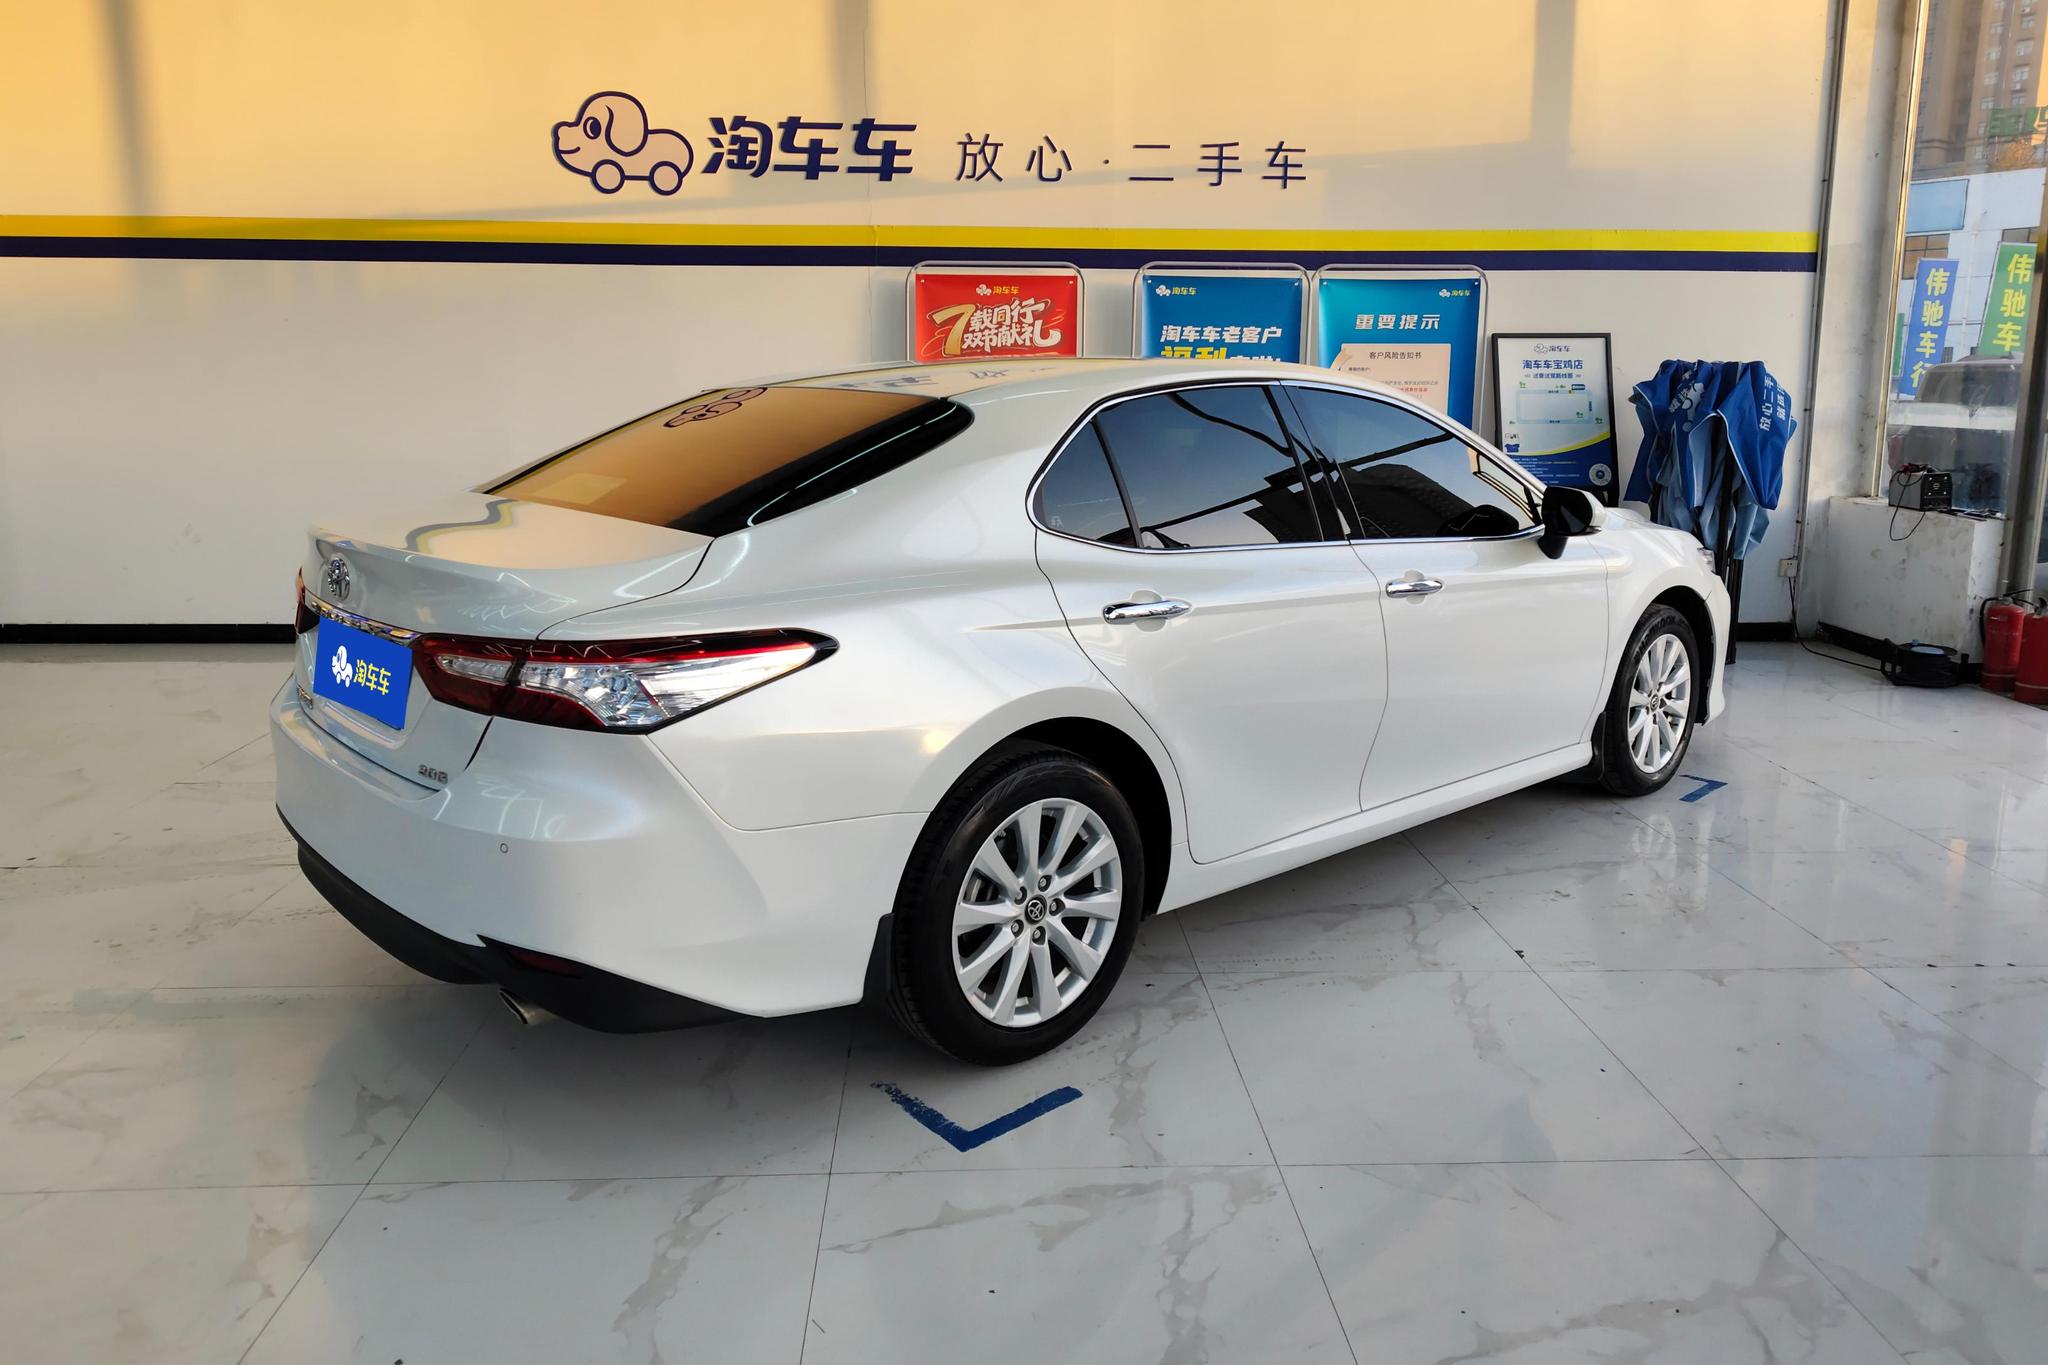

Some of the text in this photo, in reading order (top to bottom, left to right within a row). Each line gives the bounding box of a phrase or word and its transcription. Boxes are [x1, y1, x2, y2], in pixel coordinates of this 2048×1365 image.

[701, 116, 917, 182] 淘车车
[956, 134, 1307, 189] 放心·二手车
[993, 286, 1020, 295] 淘车车
[1172, 287, 1197, 296] 淘车车
[1992, 254, 2034, 351] 伟驰车
[1354, 314, 1440, 330] 重要提示
[963, 320, 1062, 352] 双节献礼
[1160, 325, 1283, 344] 淘车车老客户
[1369, 351, 1422, 360] 客户风险告知书
[1523, 359, 1583, 370] 淘车车宝鸡店
